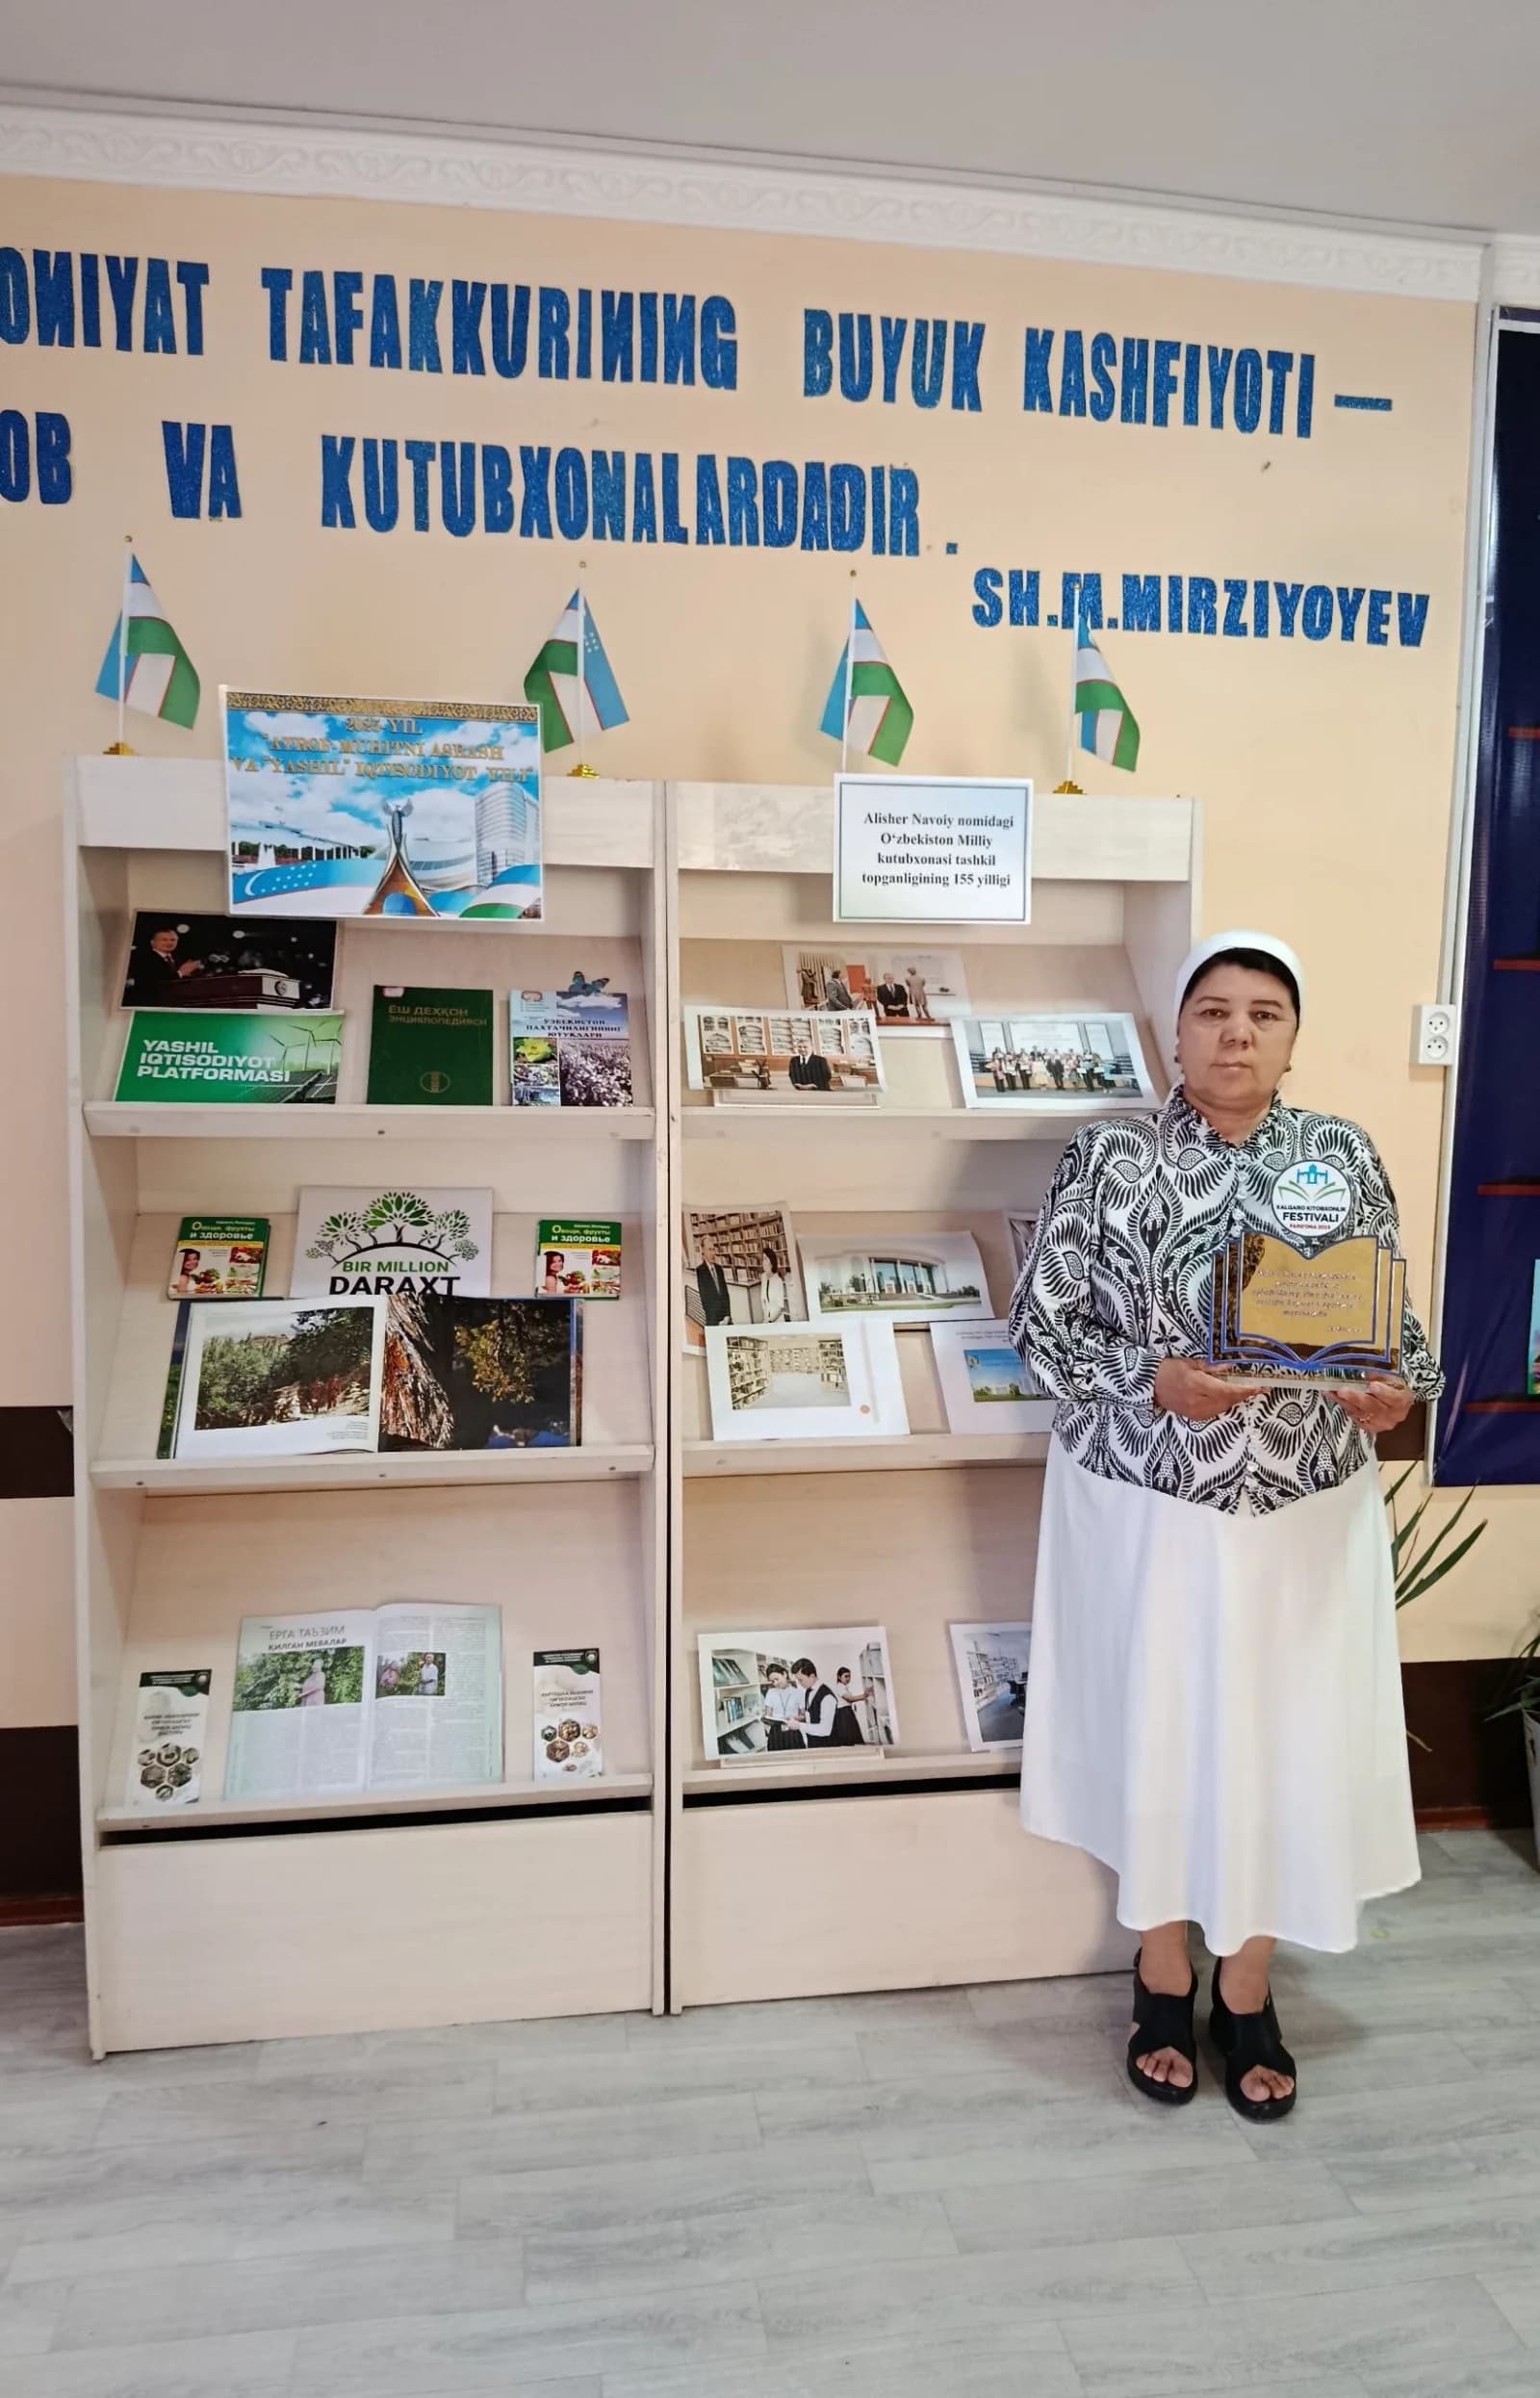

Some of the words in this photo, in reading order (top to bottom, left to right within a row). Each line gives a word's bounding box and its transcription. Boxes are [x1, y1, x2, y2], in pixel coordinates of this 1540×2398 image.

[803, 309, 986, 412] BUYUK
[1023, 327, 1316, 439] KASHFIYOTI
[0, 411, 72, 504] OB
[162, 421, 242, 519] VA
[863, 812, 909, 825] Alisher
[911, 813, 954, 829] Navoiy
[958, 815, 1014, 830] nomidagi
[957, 835, 993, 849] Milliy
[877, 852, 952, 865] kutubxonasi
[956, 855, 996, 866] tashkil
[862, 872, 950, 887] topganligining
[954, 873, 974, 885] 155
[977, 873, 1011, 888] yilligi
[143, 1040, 218, 1054] YASHIL
[141, 1053, 275, 1069] IQTISODIYOT
[137, 1066, 291, 1083] PLATFORMASI
[1282, 1211, 1340, 1223] FESTIVALI
[199, 1231, 254, 1240] здоровье
[560, 1235, 611, 1244] здоровье
[343, 1261, 372, 1273] BIR
[377, 1261, 449, 1273] MILLION
[328, 1276, 461, 1296] DARAXT
